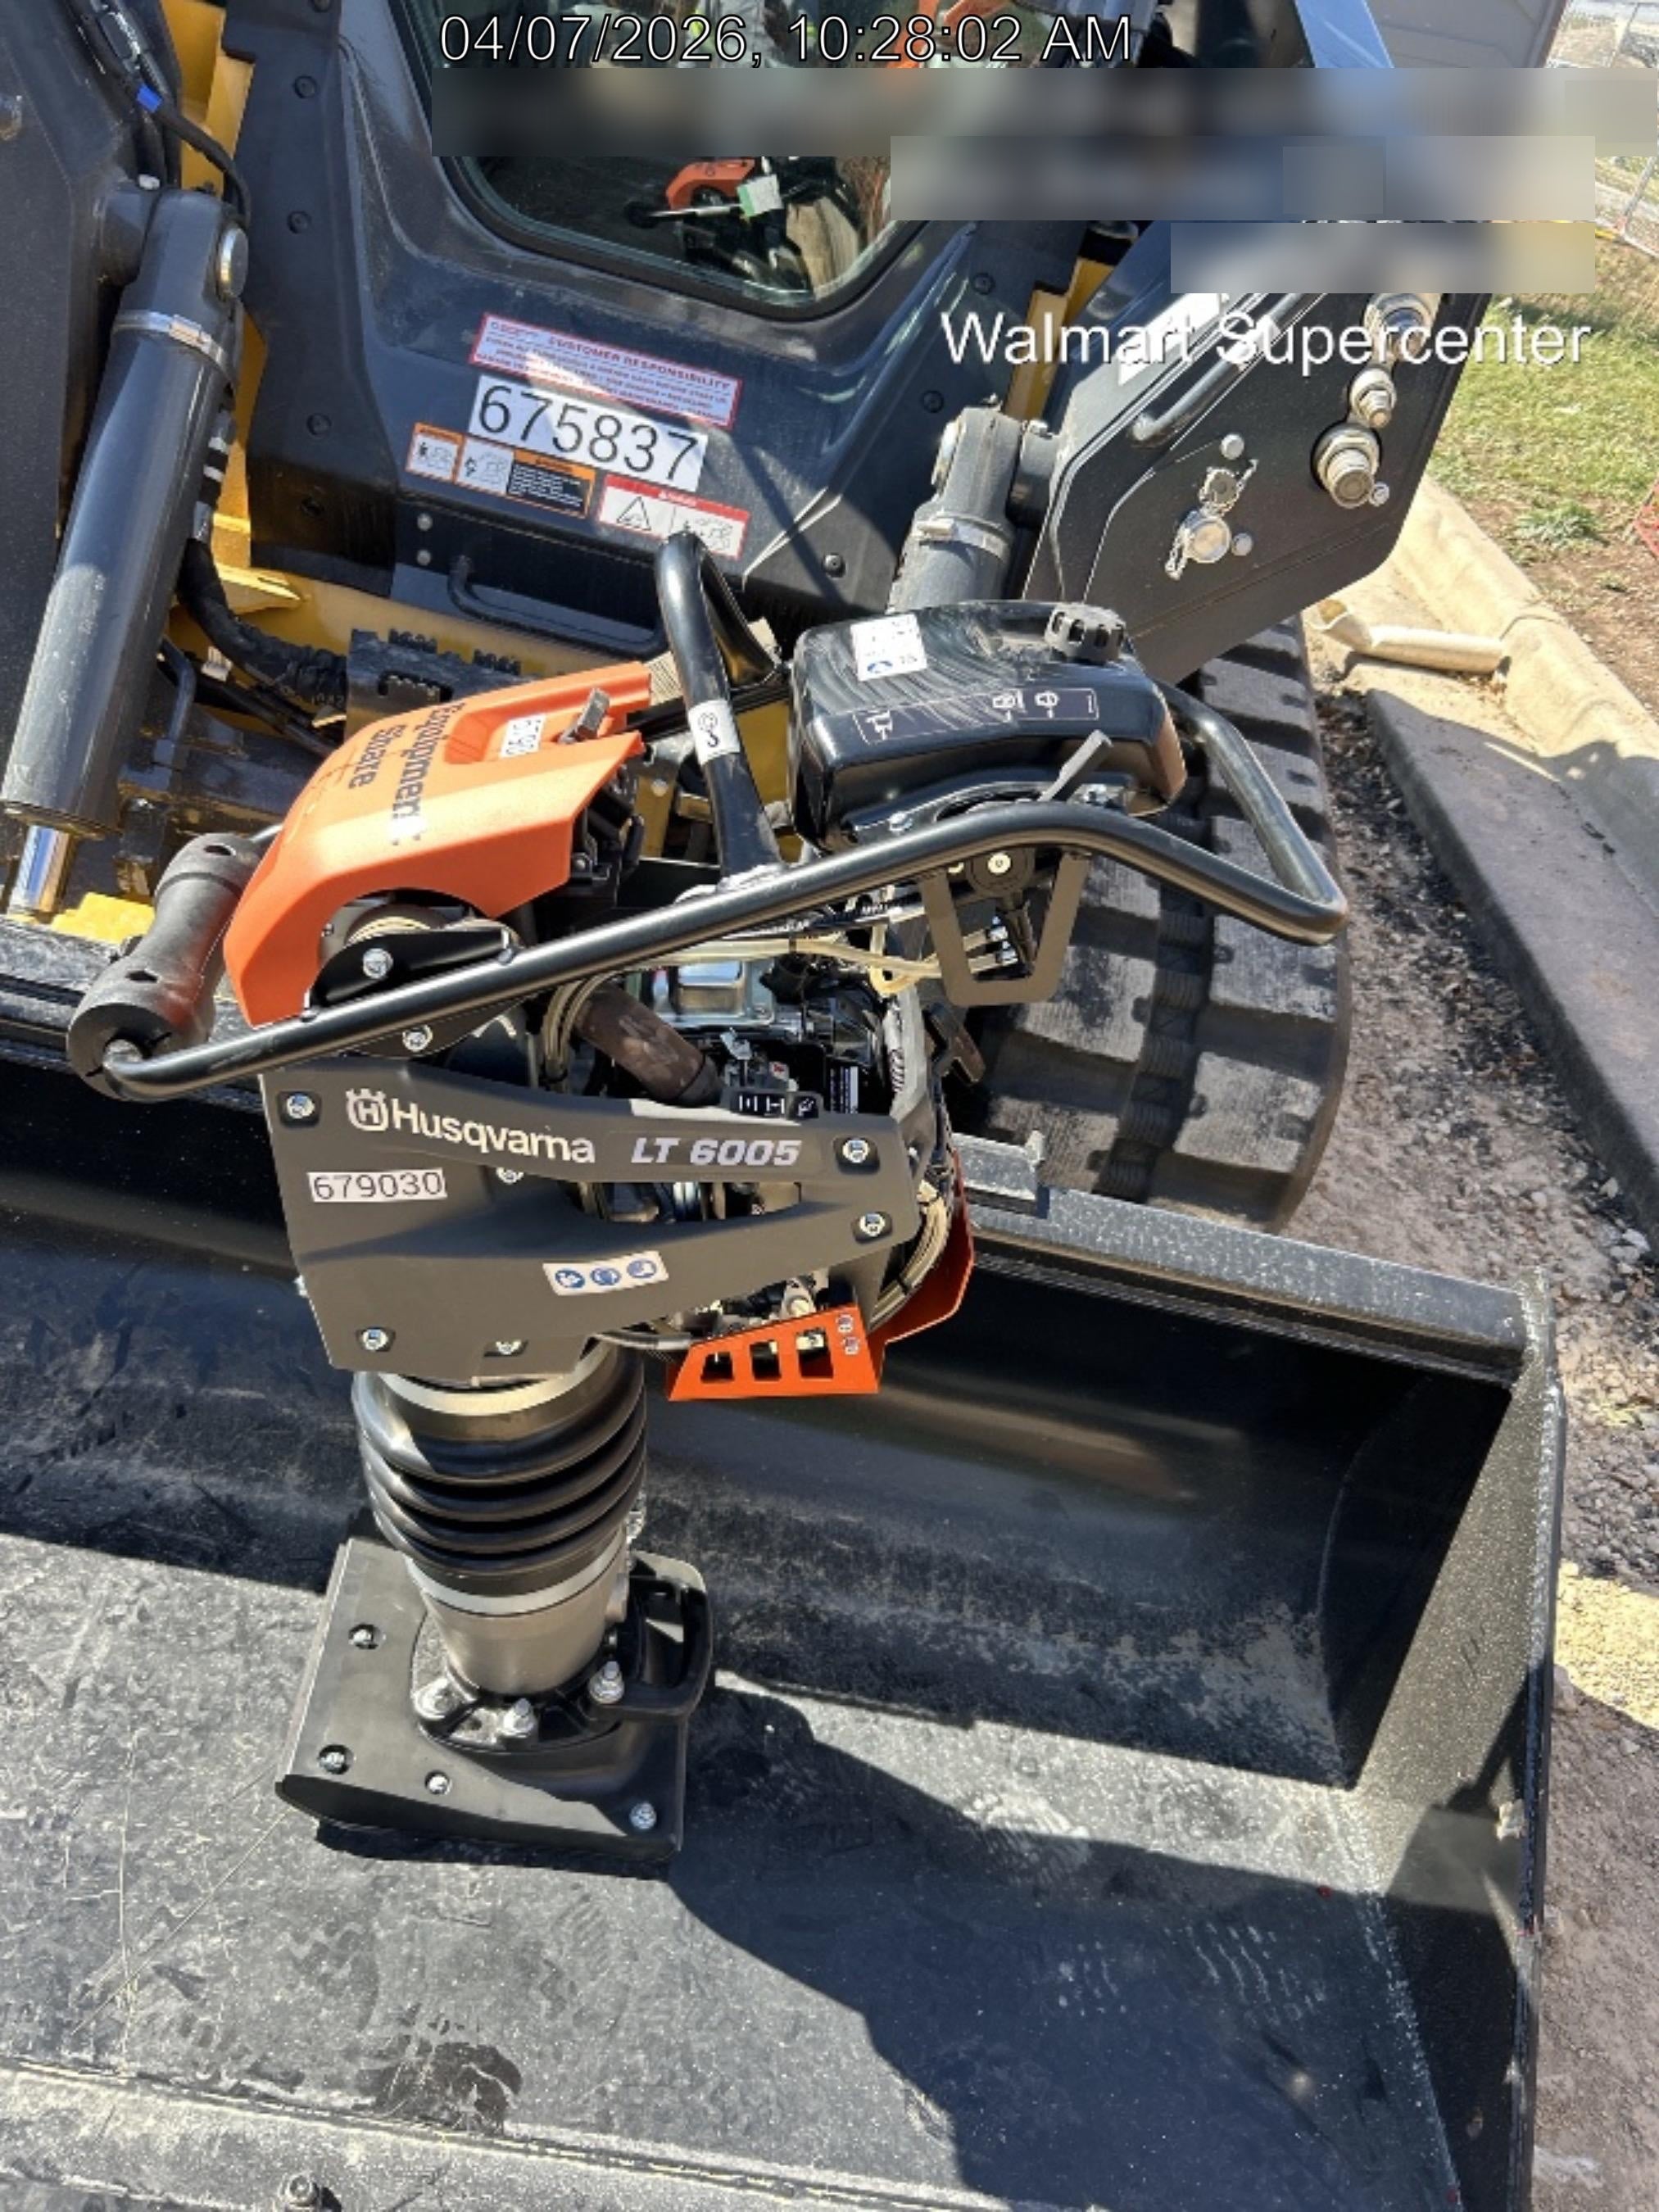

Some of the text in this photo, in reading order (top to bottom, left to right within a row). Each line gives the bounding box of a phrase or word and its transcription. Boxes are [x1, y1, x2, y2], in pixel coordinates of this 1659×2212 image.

[478, 384, 699, 481] 675837
[392, 702, 465, 845] Equipmen
[391, 1098, 596, 1164] Husqvarna
[631, 1137, 802, 1167] LT 6005
[314, 1171, 442, 1199] 679030
